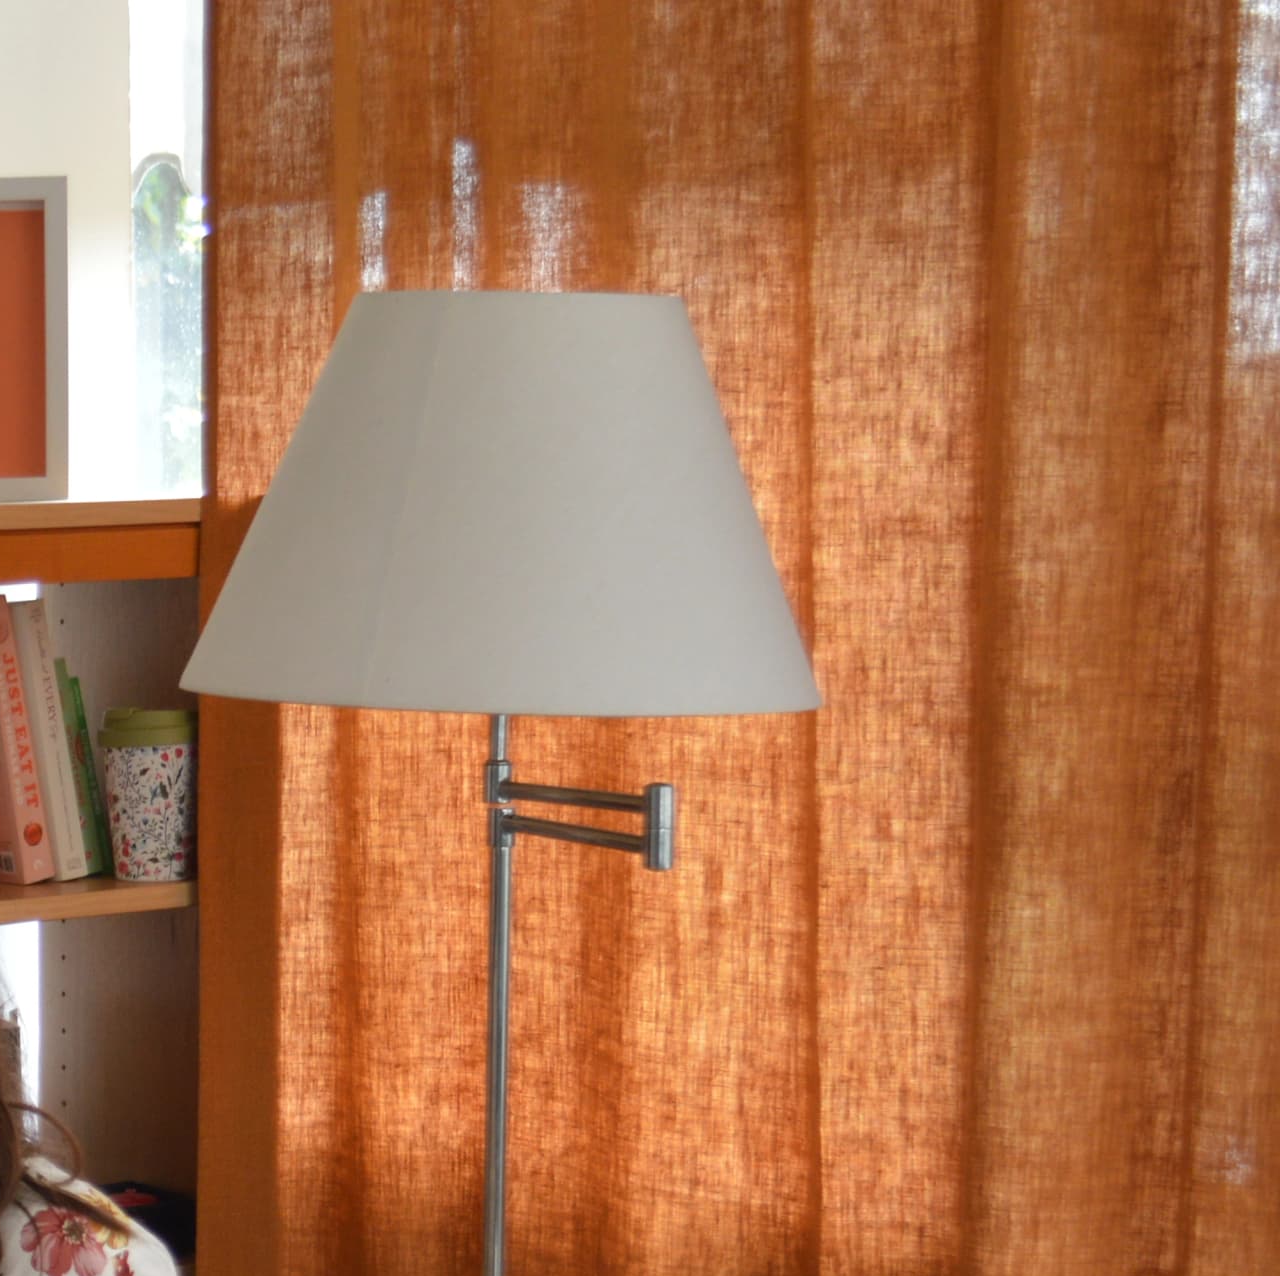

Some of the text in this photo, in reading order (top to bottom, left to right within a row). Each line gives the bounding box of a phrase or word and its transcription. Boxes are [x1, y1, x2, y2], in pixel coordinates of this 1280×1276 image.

[0, 651, 39, 809] JUST EAT IT
